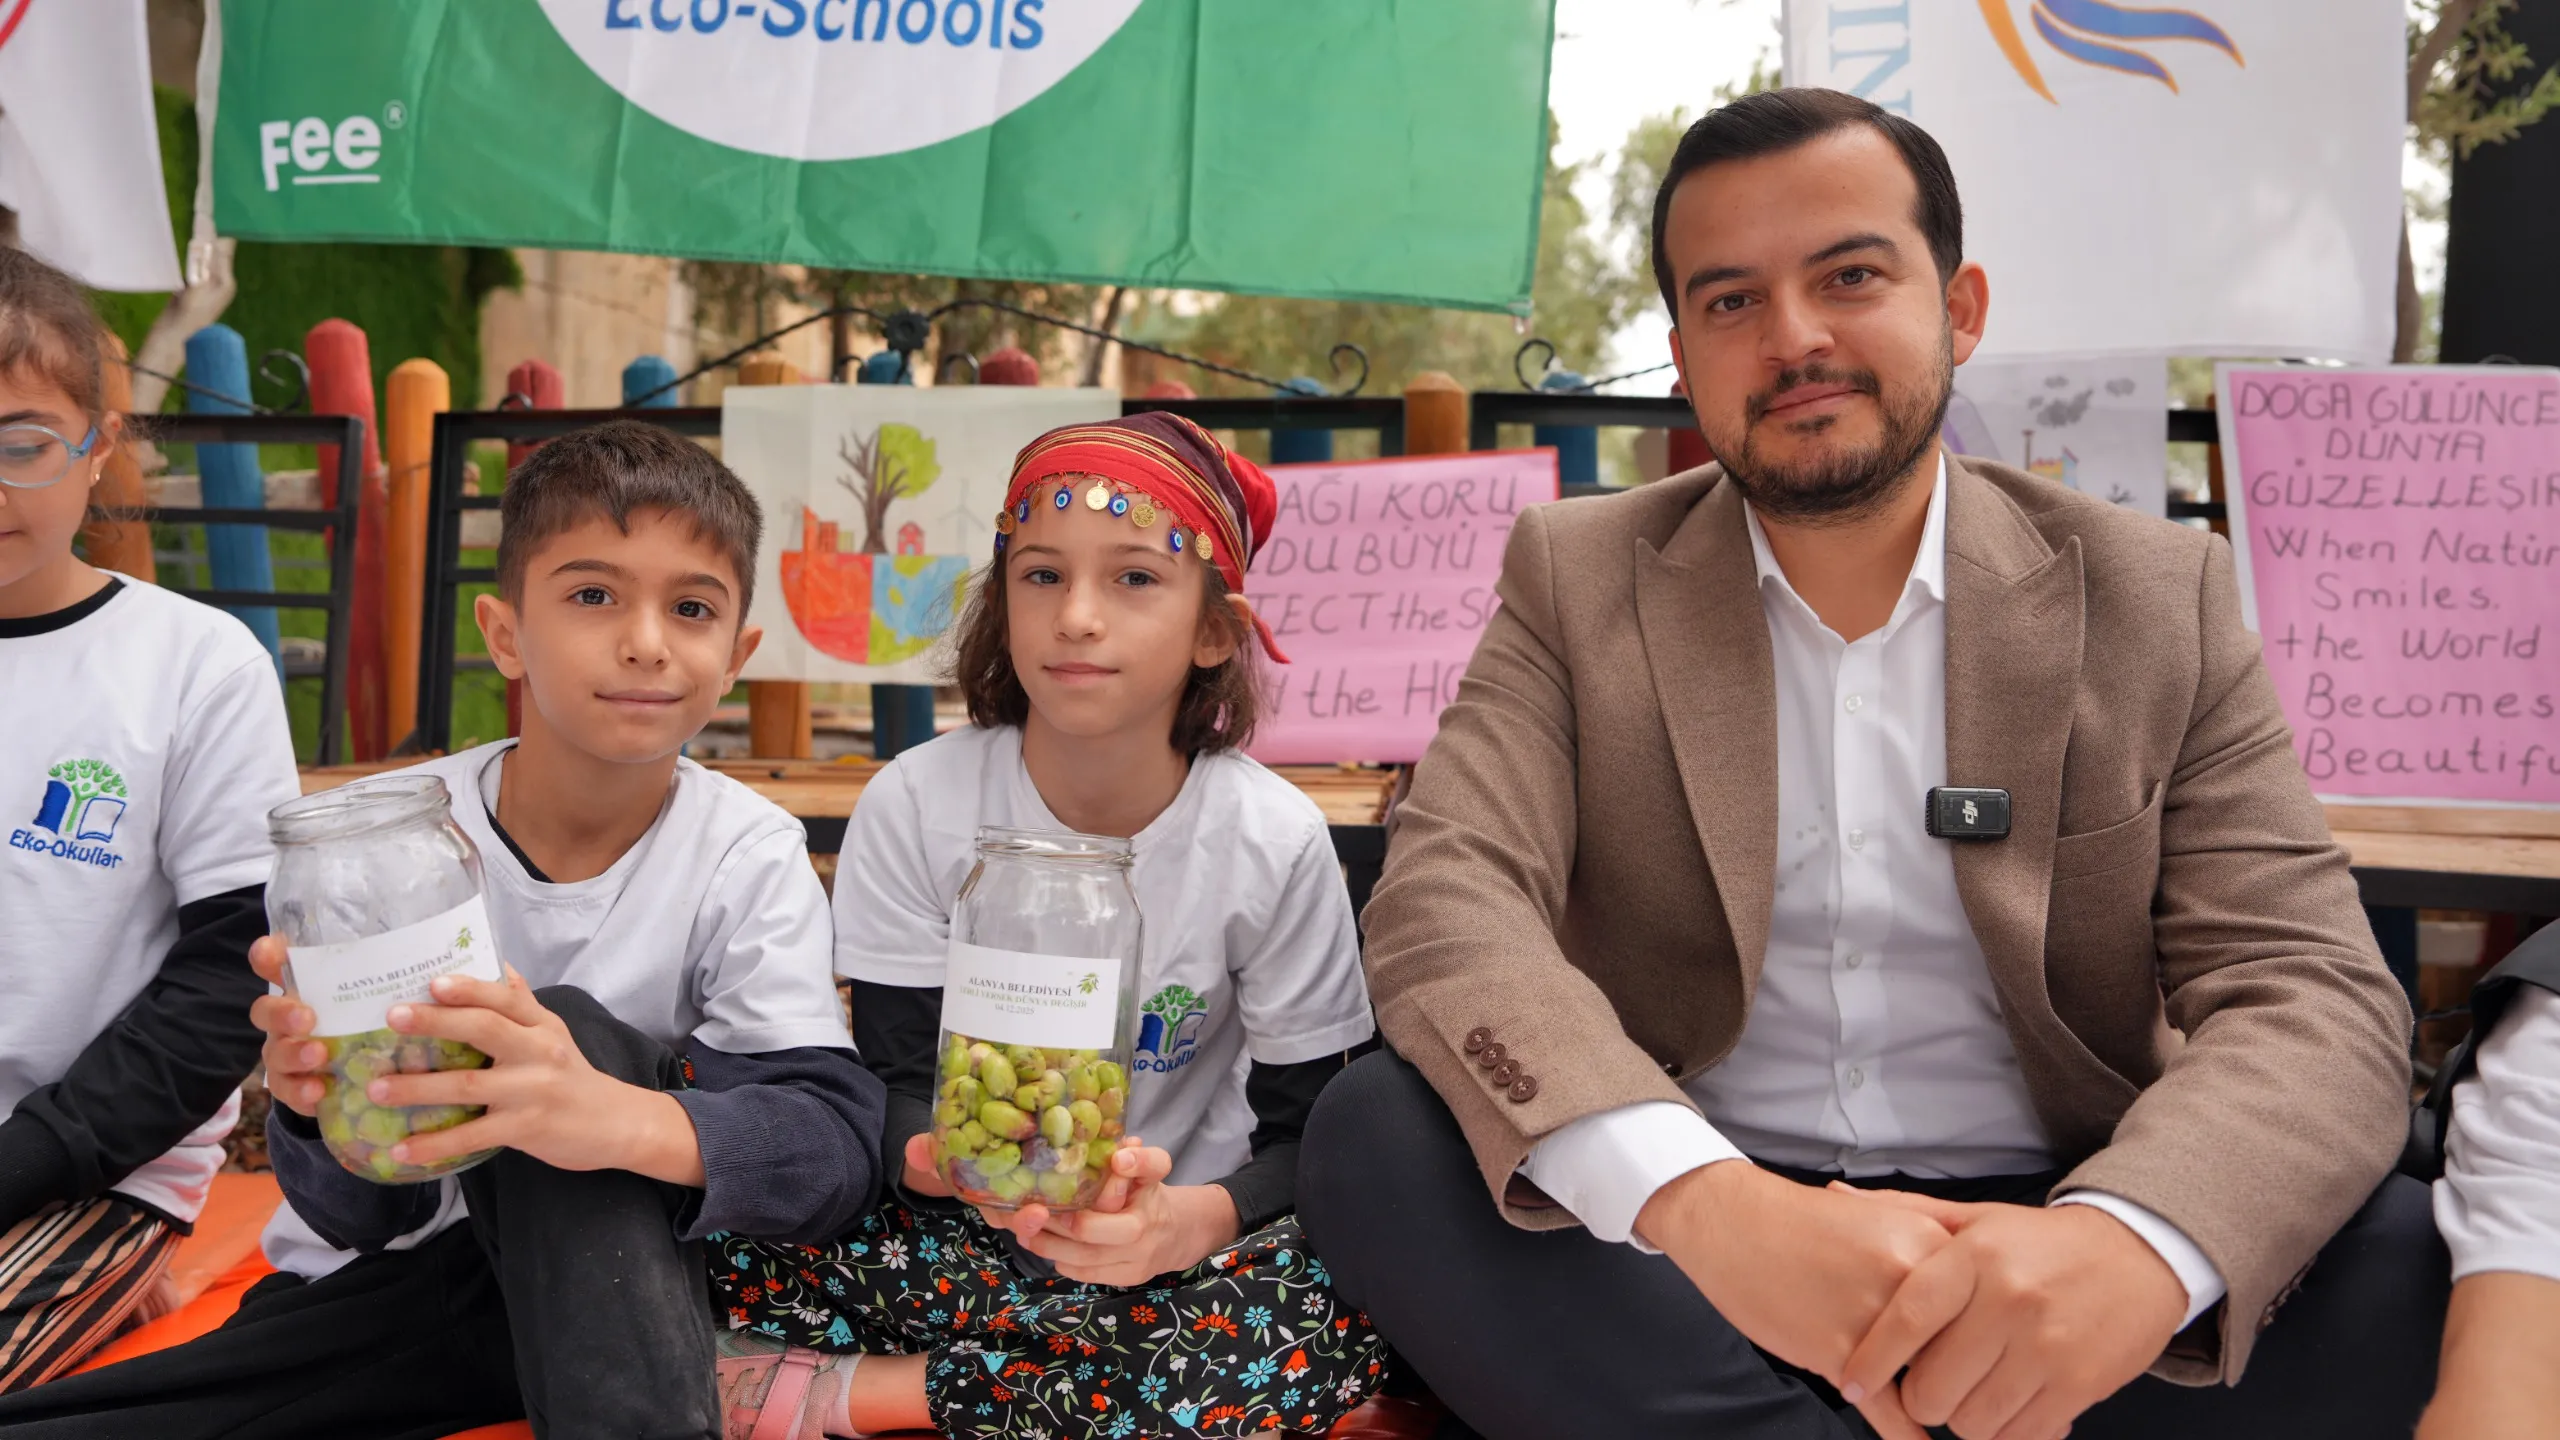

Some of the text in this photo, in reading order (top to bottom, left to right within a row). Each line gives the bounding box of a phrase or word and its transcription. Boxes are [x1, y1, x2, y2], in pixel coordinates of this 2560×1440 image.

[2367, 380, 2560, 427] GÜLÜNCE
[2325, 423, 2486, 463] DÜNYA
[1379, 476, 1518, 523] KORU
[1353, 520, 1478, 576] BÜYÜ
[2264, 526, 2396, 562] When
[1388, 592, 1448, 632] the
[2276, 623, 2541, 661] the World
[1303, 667, 1383, 719] the
[2305, 671, 2556, 720] Becomes
[9, 828, 124, 869] Eko-Okullar
[968, 976, 1071, 997] ALANYA BELEDİYESİ
